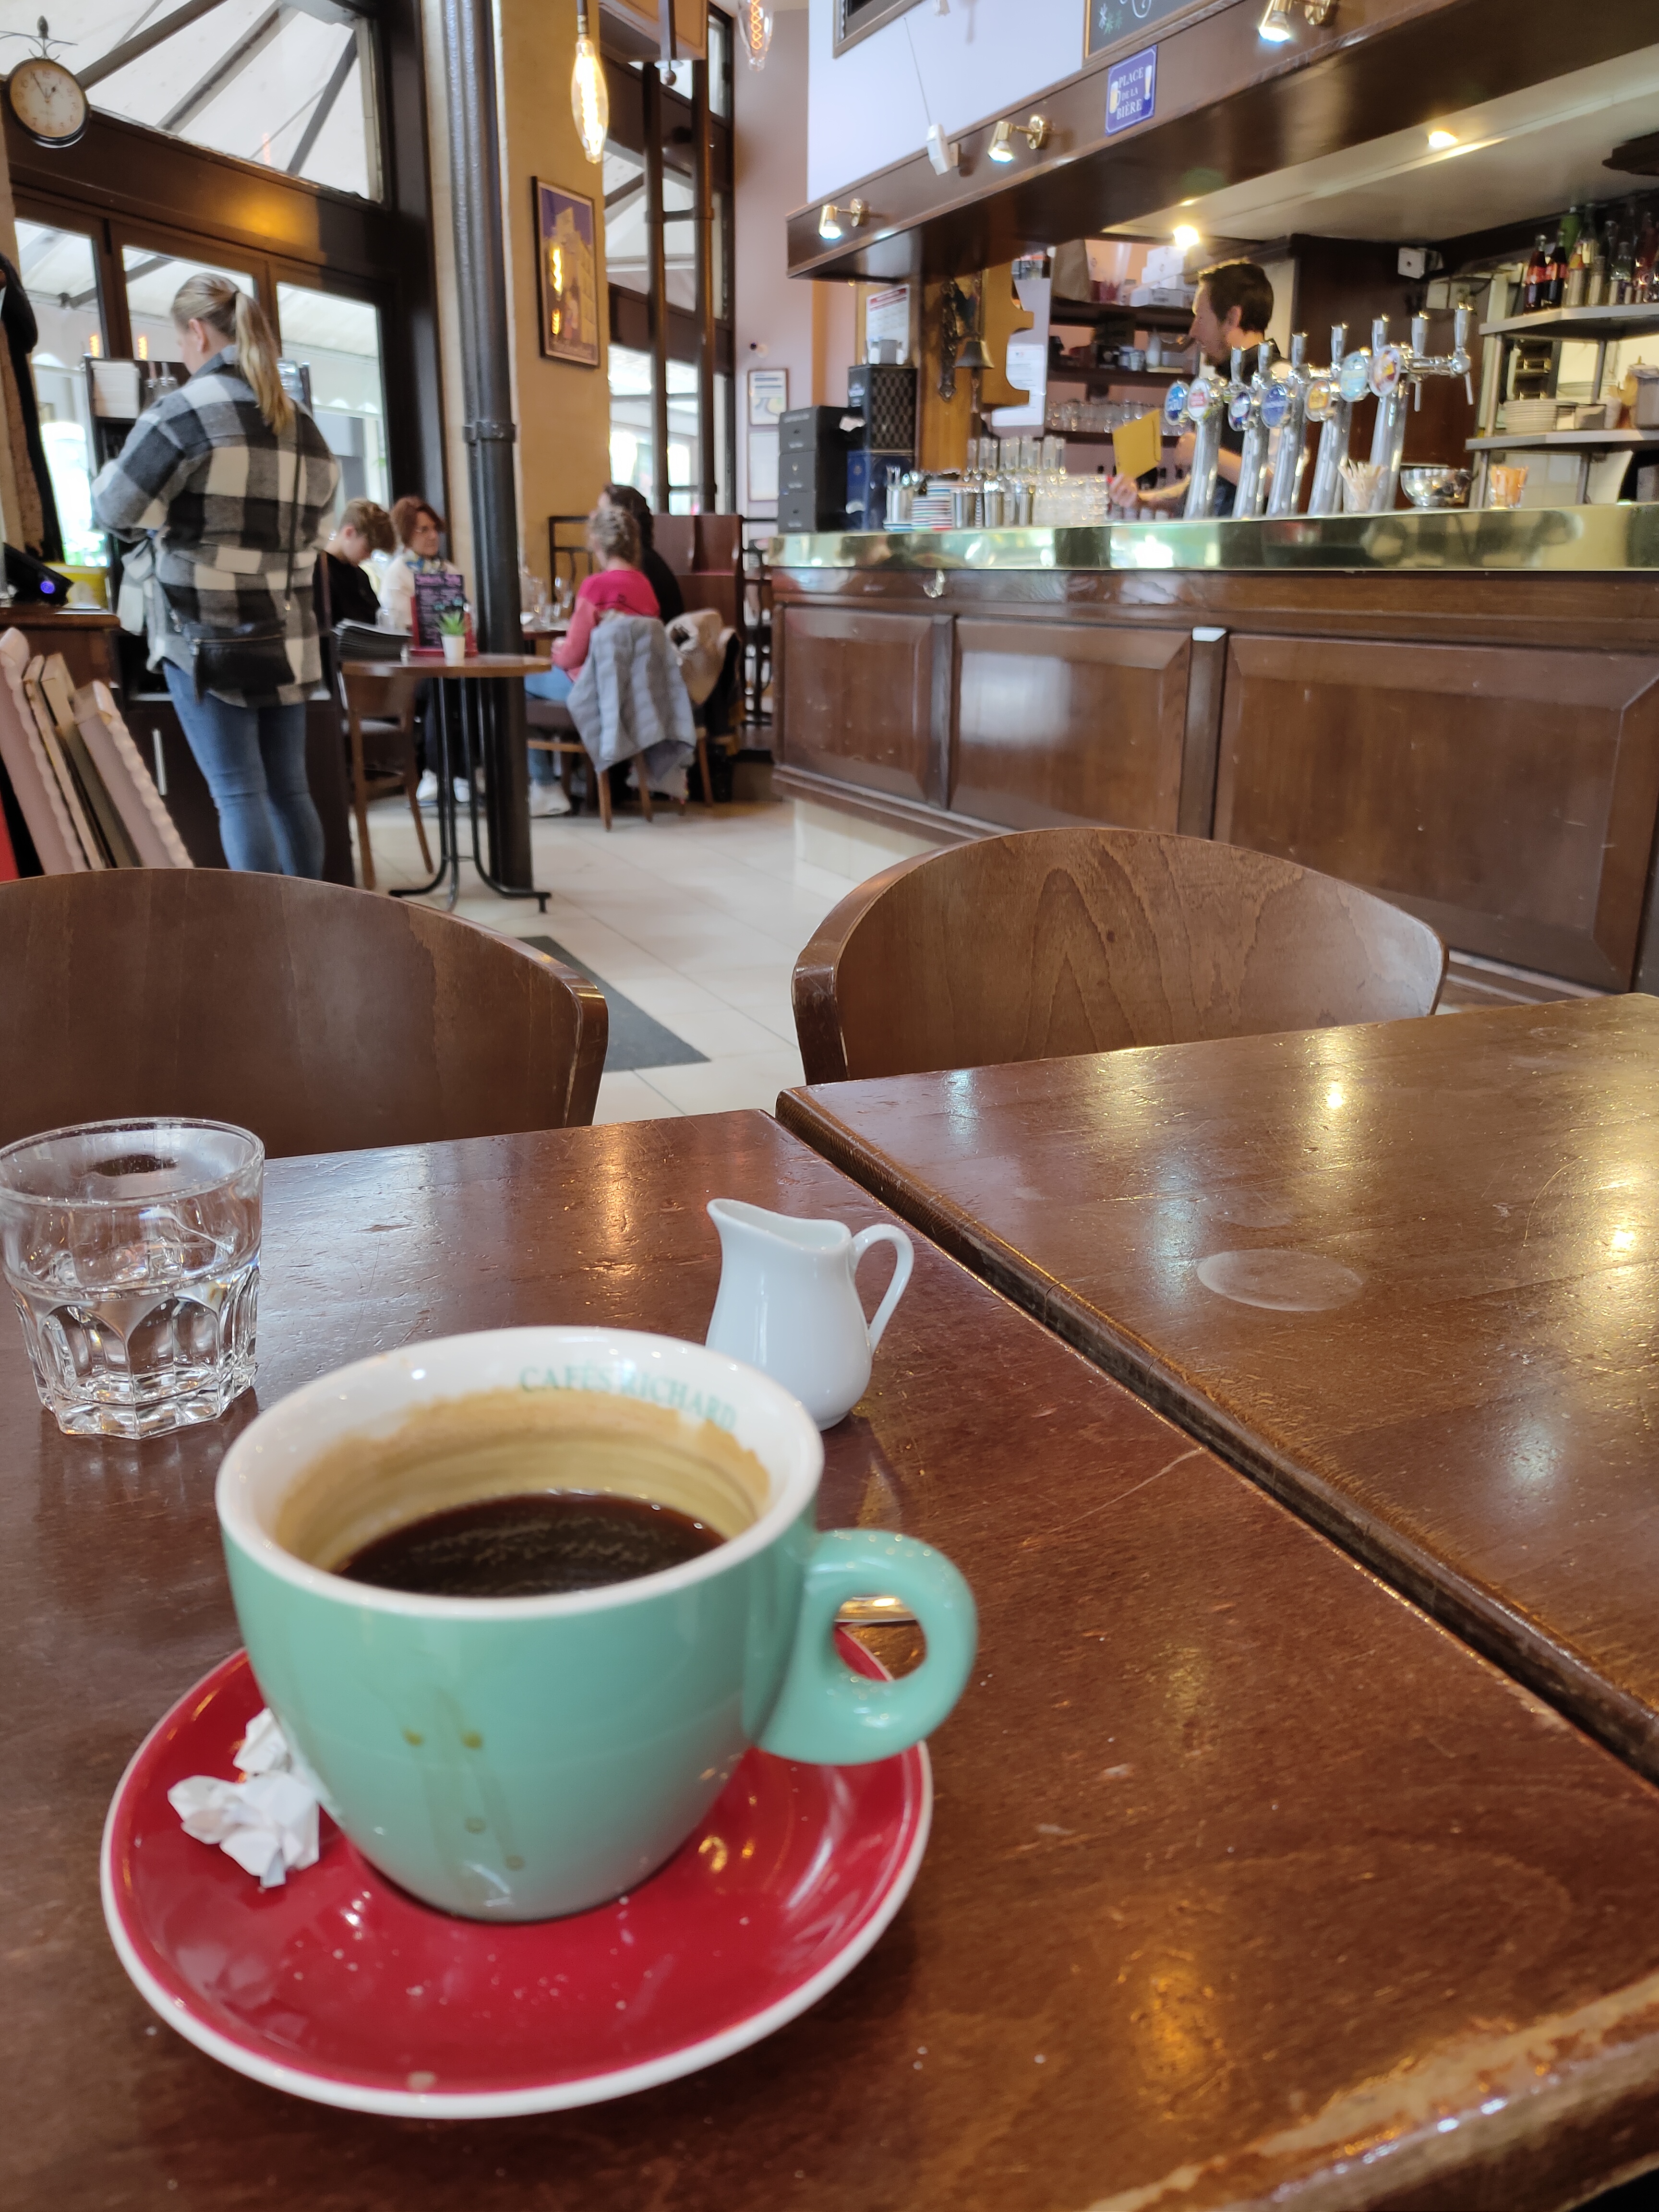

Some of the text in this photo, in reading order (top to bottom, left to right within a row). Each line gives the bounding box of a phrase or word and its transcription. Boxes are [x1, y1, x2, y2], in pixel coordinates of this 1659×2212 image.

[1118, 67, 1143, 88] PLACE
[1130, 87, 1139, 97] LA
[1117, 99, 1142, 120] BIÈRE
